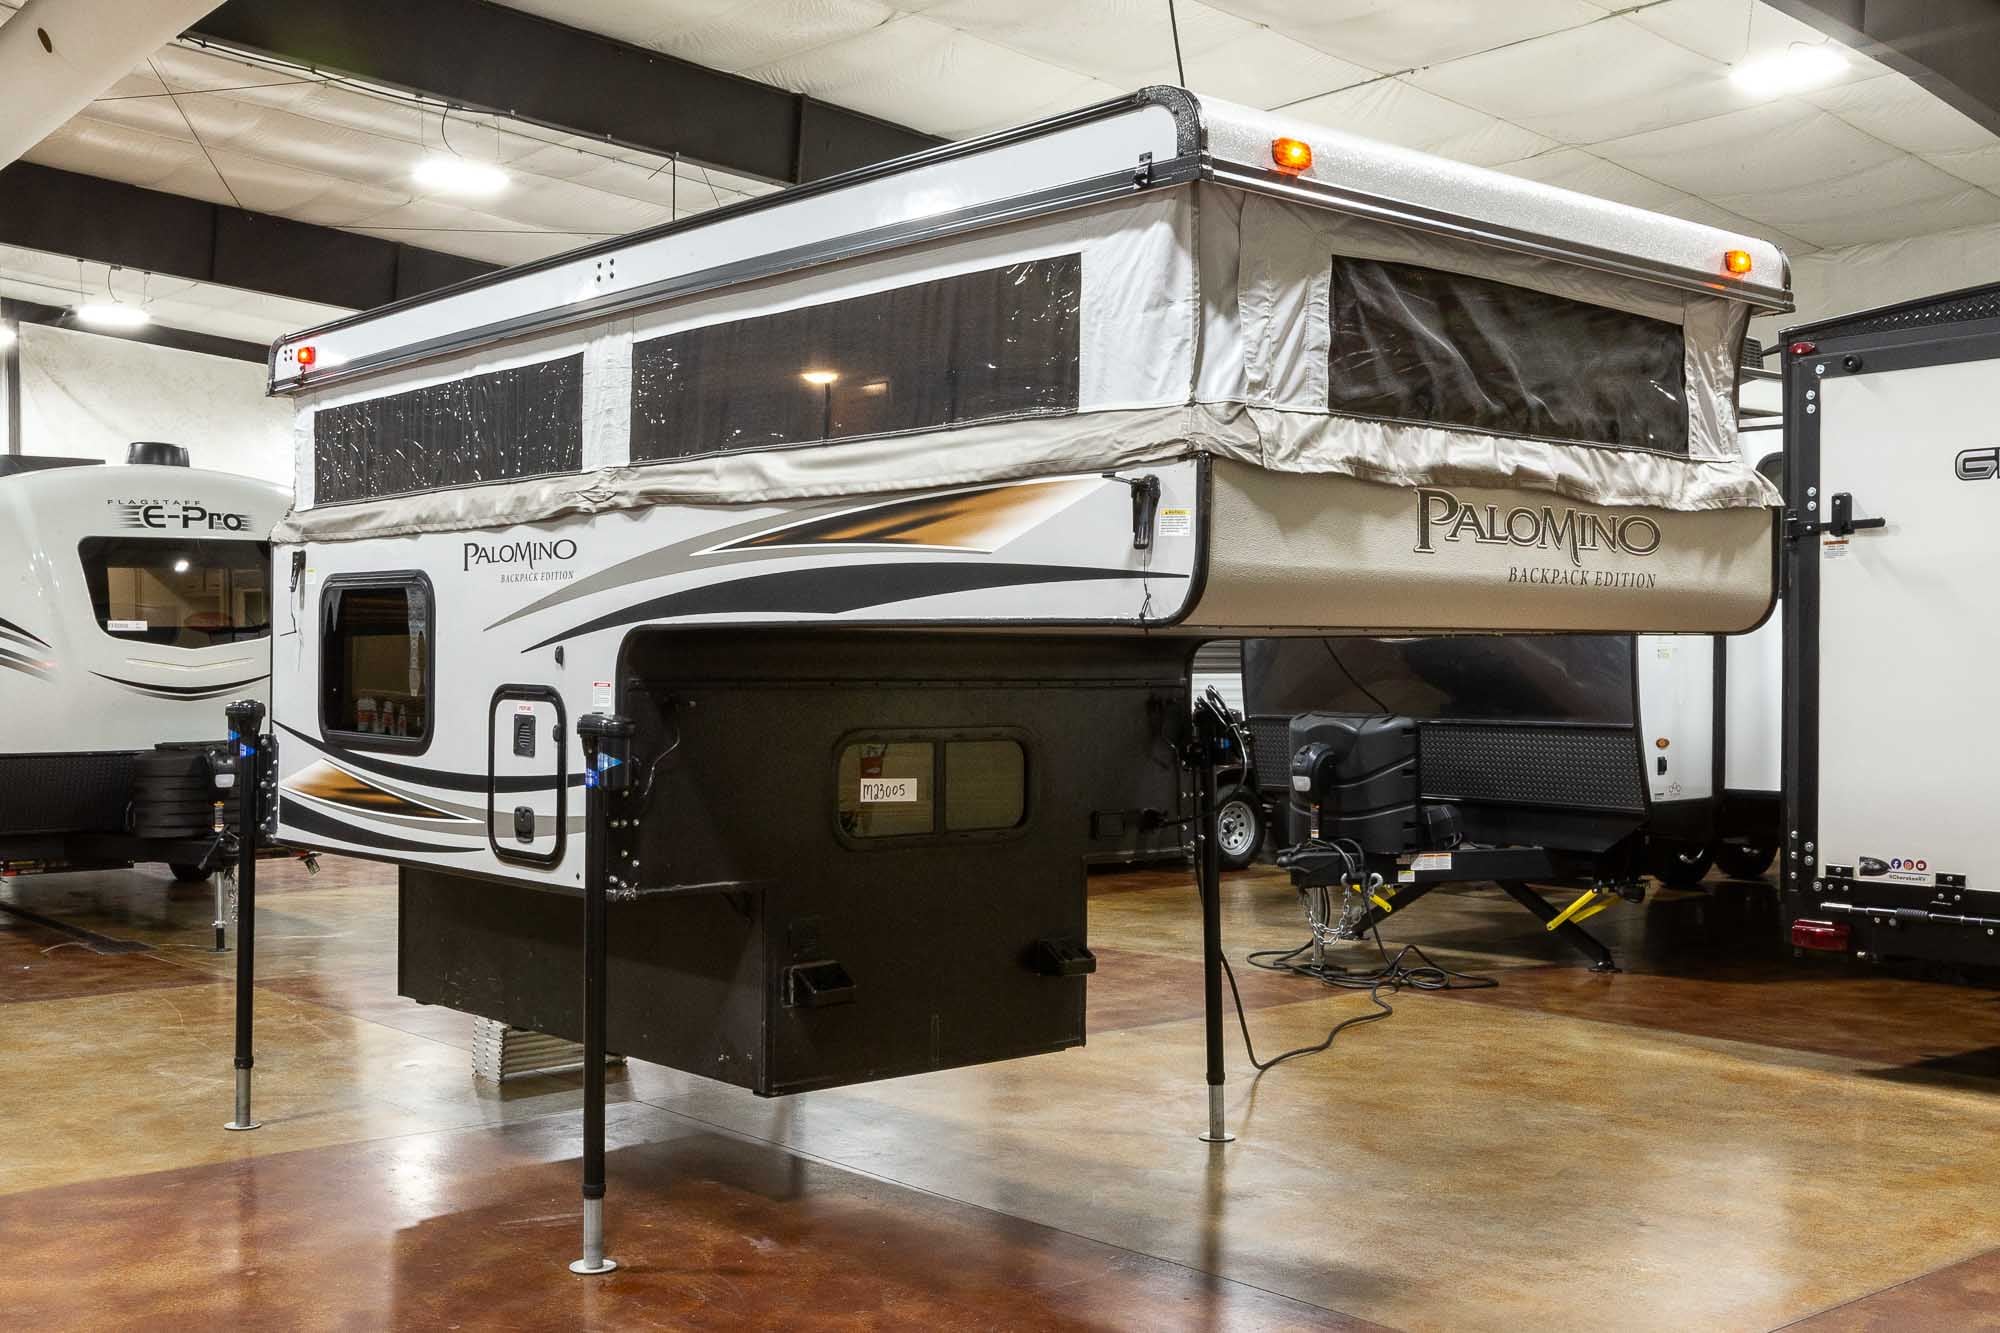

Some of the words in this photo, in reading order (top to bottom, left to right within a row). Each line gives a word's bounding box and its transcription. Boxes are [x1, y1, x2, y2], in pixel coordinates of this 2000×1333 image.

[1954, 446, 2000, 481] G
[142, 505, 243, 531] E-Pro
[1414, 487, 1662, 567] PALOMINO
[463, 538, 577, 572] PALOMINO
[500, 572, 538, 583] BACKPACK
[540, 570, 575, 581] EDITION
[1508, 567, 1588, 586] BACKPACK
[1595, 572, 1656, 589] EDITION
[863, 783, 905, 801] M23005
